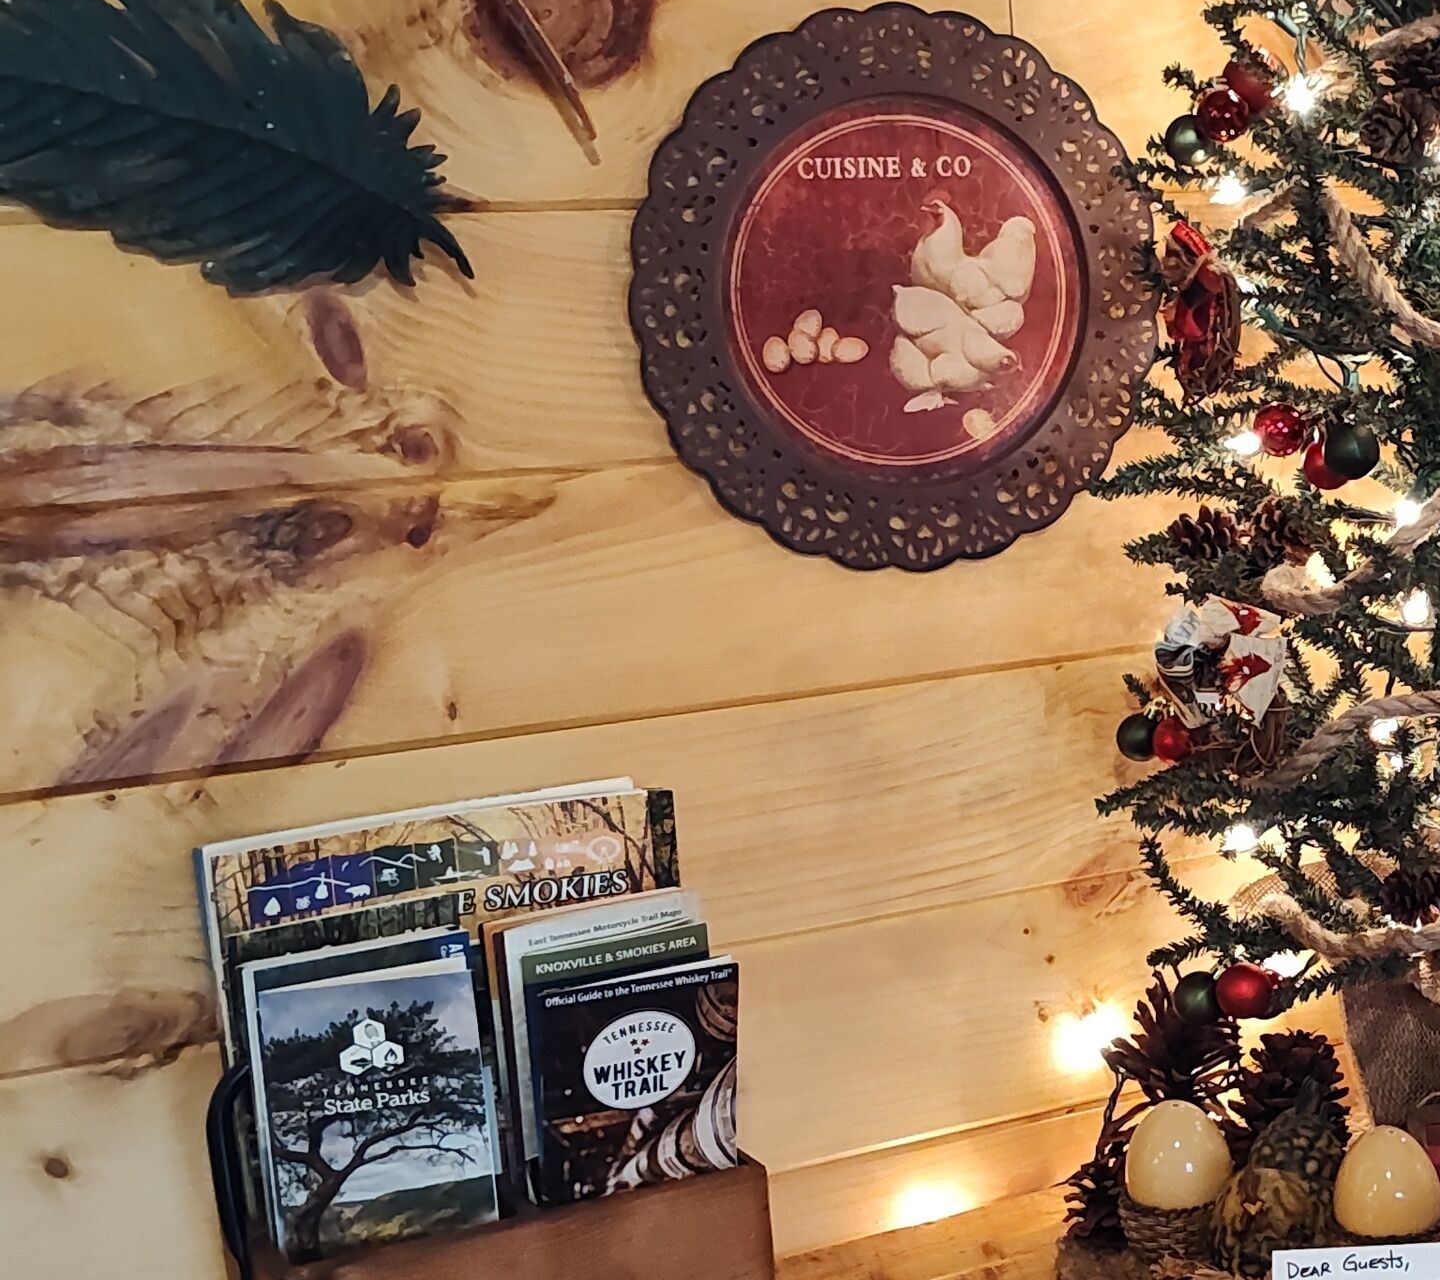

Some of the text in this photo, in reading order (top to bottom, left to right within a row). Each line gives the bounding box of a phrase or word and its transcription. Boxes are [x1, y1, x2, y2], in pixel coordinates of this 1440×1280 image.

[797, 155, 972, 180] CUISINE & CO
[484, 870, 629, 911] SMOKIES
[535, 935, 698, 975] KNOXVILLE & SMOKIES AREA
[545, 993, 576, 1008] Official
[577, 990, 603, 1003] Guide
[604, 989, 614, 999] to
[615, 985, 630, 997] the
[630, 978, 674, 993] Tennessee
[674, 973, 710, 986] Whiskey
[603, 1021, 677, 1045] TENNESSEE
[593, 1050, 686, 1085] WHISKEY
[323, 1089, 431, 1116] State Parks
[611, 1074, 669, 1100] TRAIL
